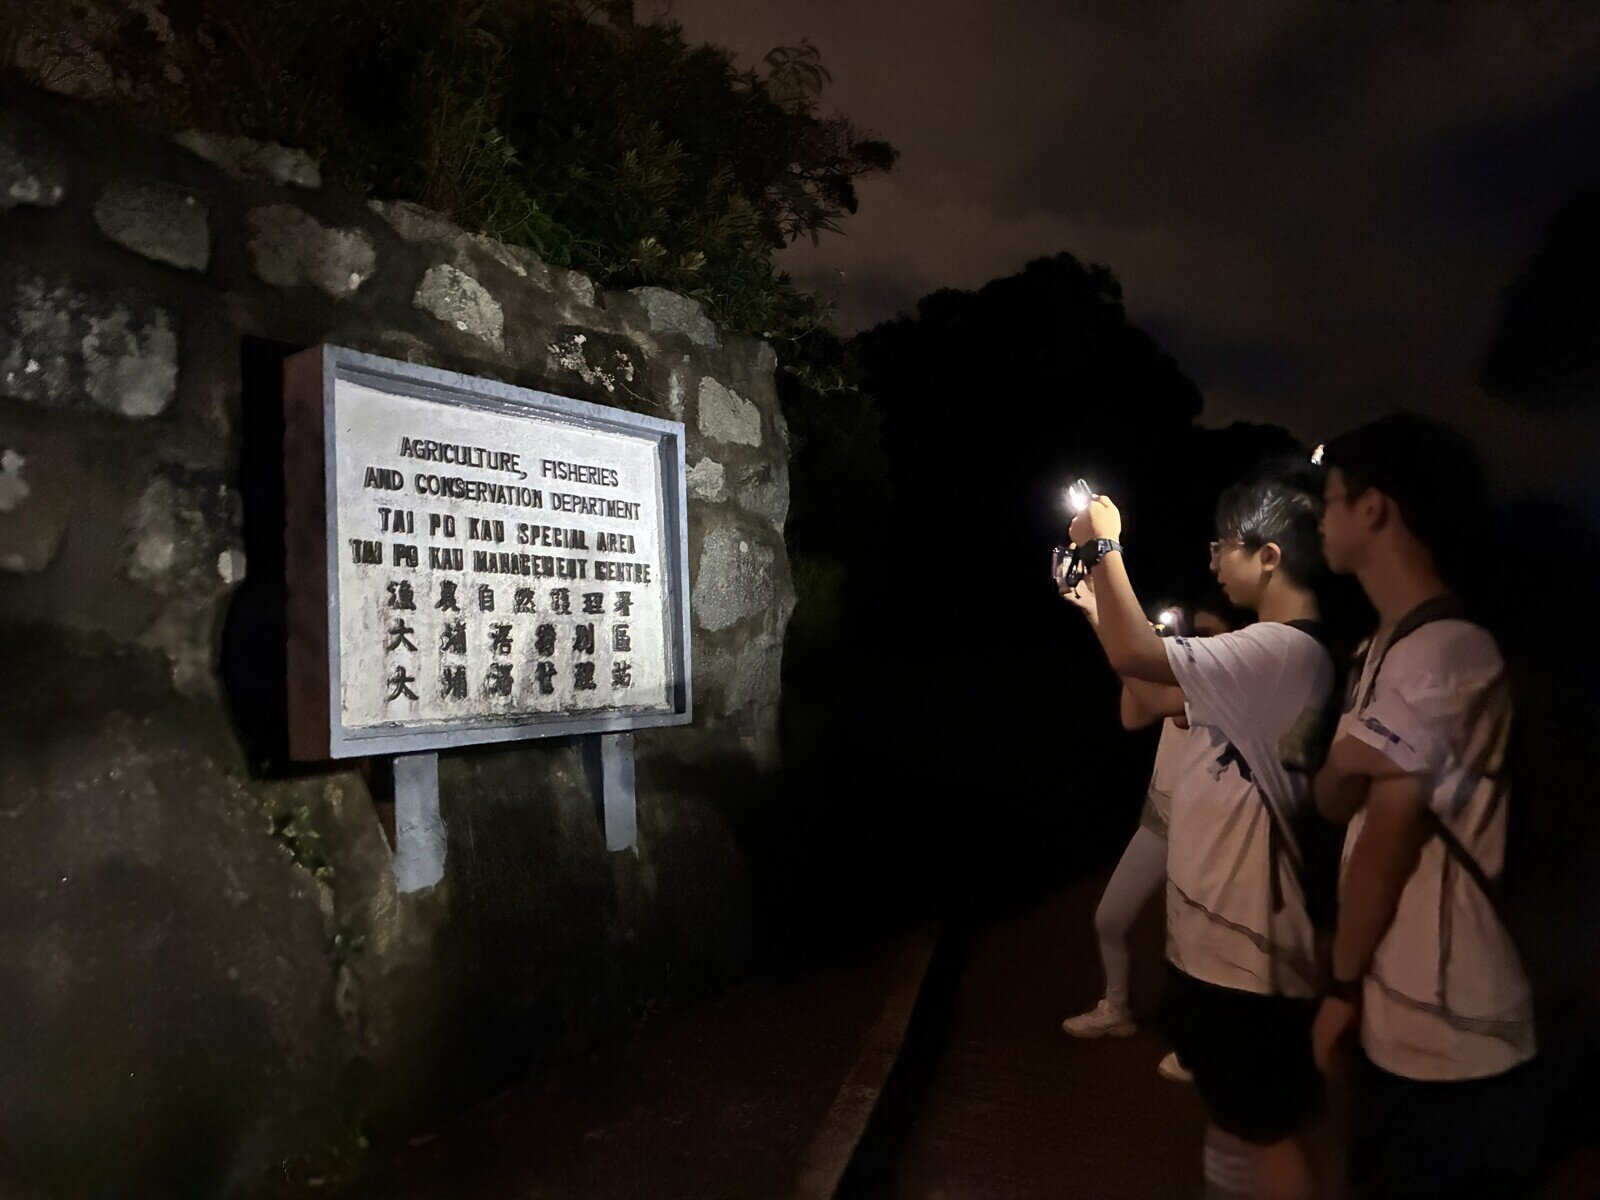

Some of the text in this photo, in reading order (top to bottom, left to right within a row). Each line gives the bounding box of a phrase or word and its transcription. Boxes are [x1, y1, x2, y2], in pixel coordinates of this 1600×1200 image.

[400, 437, 619, 487] AGRICULTURE, FISHERIES
[364, 467, 640, 520] AND CONSERVATION DEPARTMENT
[378, 507, 636, 554] TAI PO KAU SPECIAL AREA
[350, 539, 652, 583] TAI PO KAU MANAGEMENT CENTRE
[387, 580, 634, 617] 漁農自然護理署
